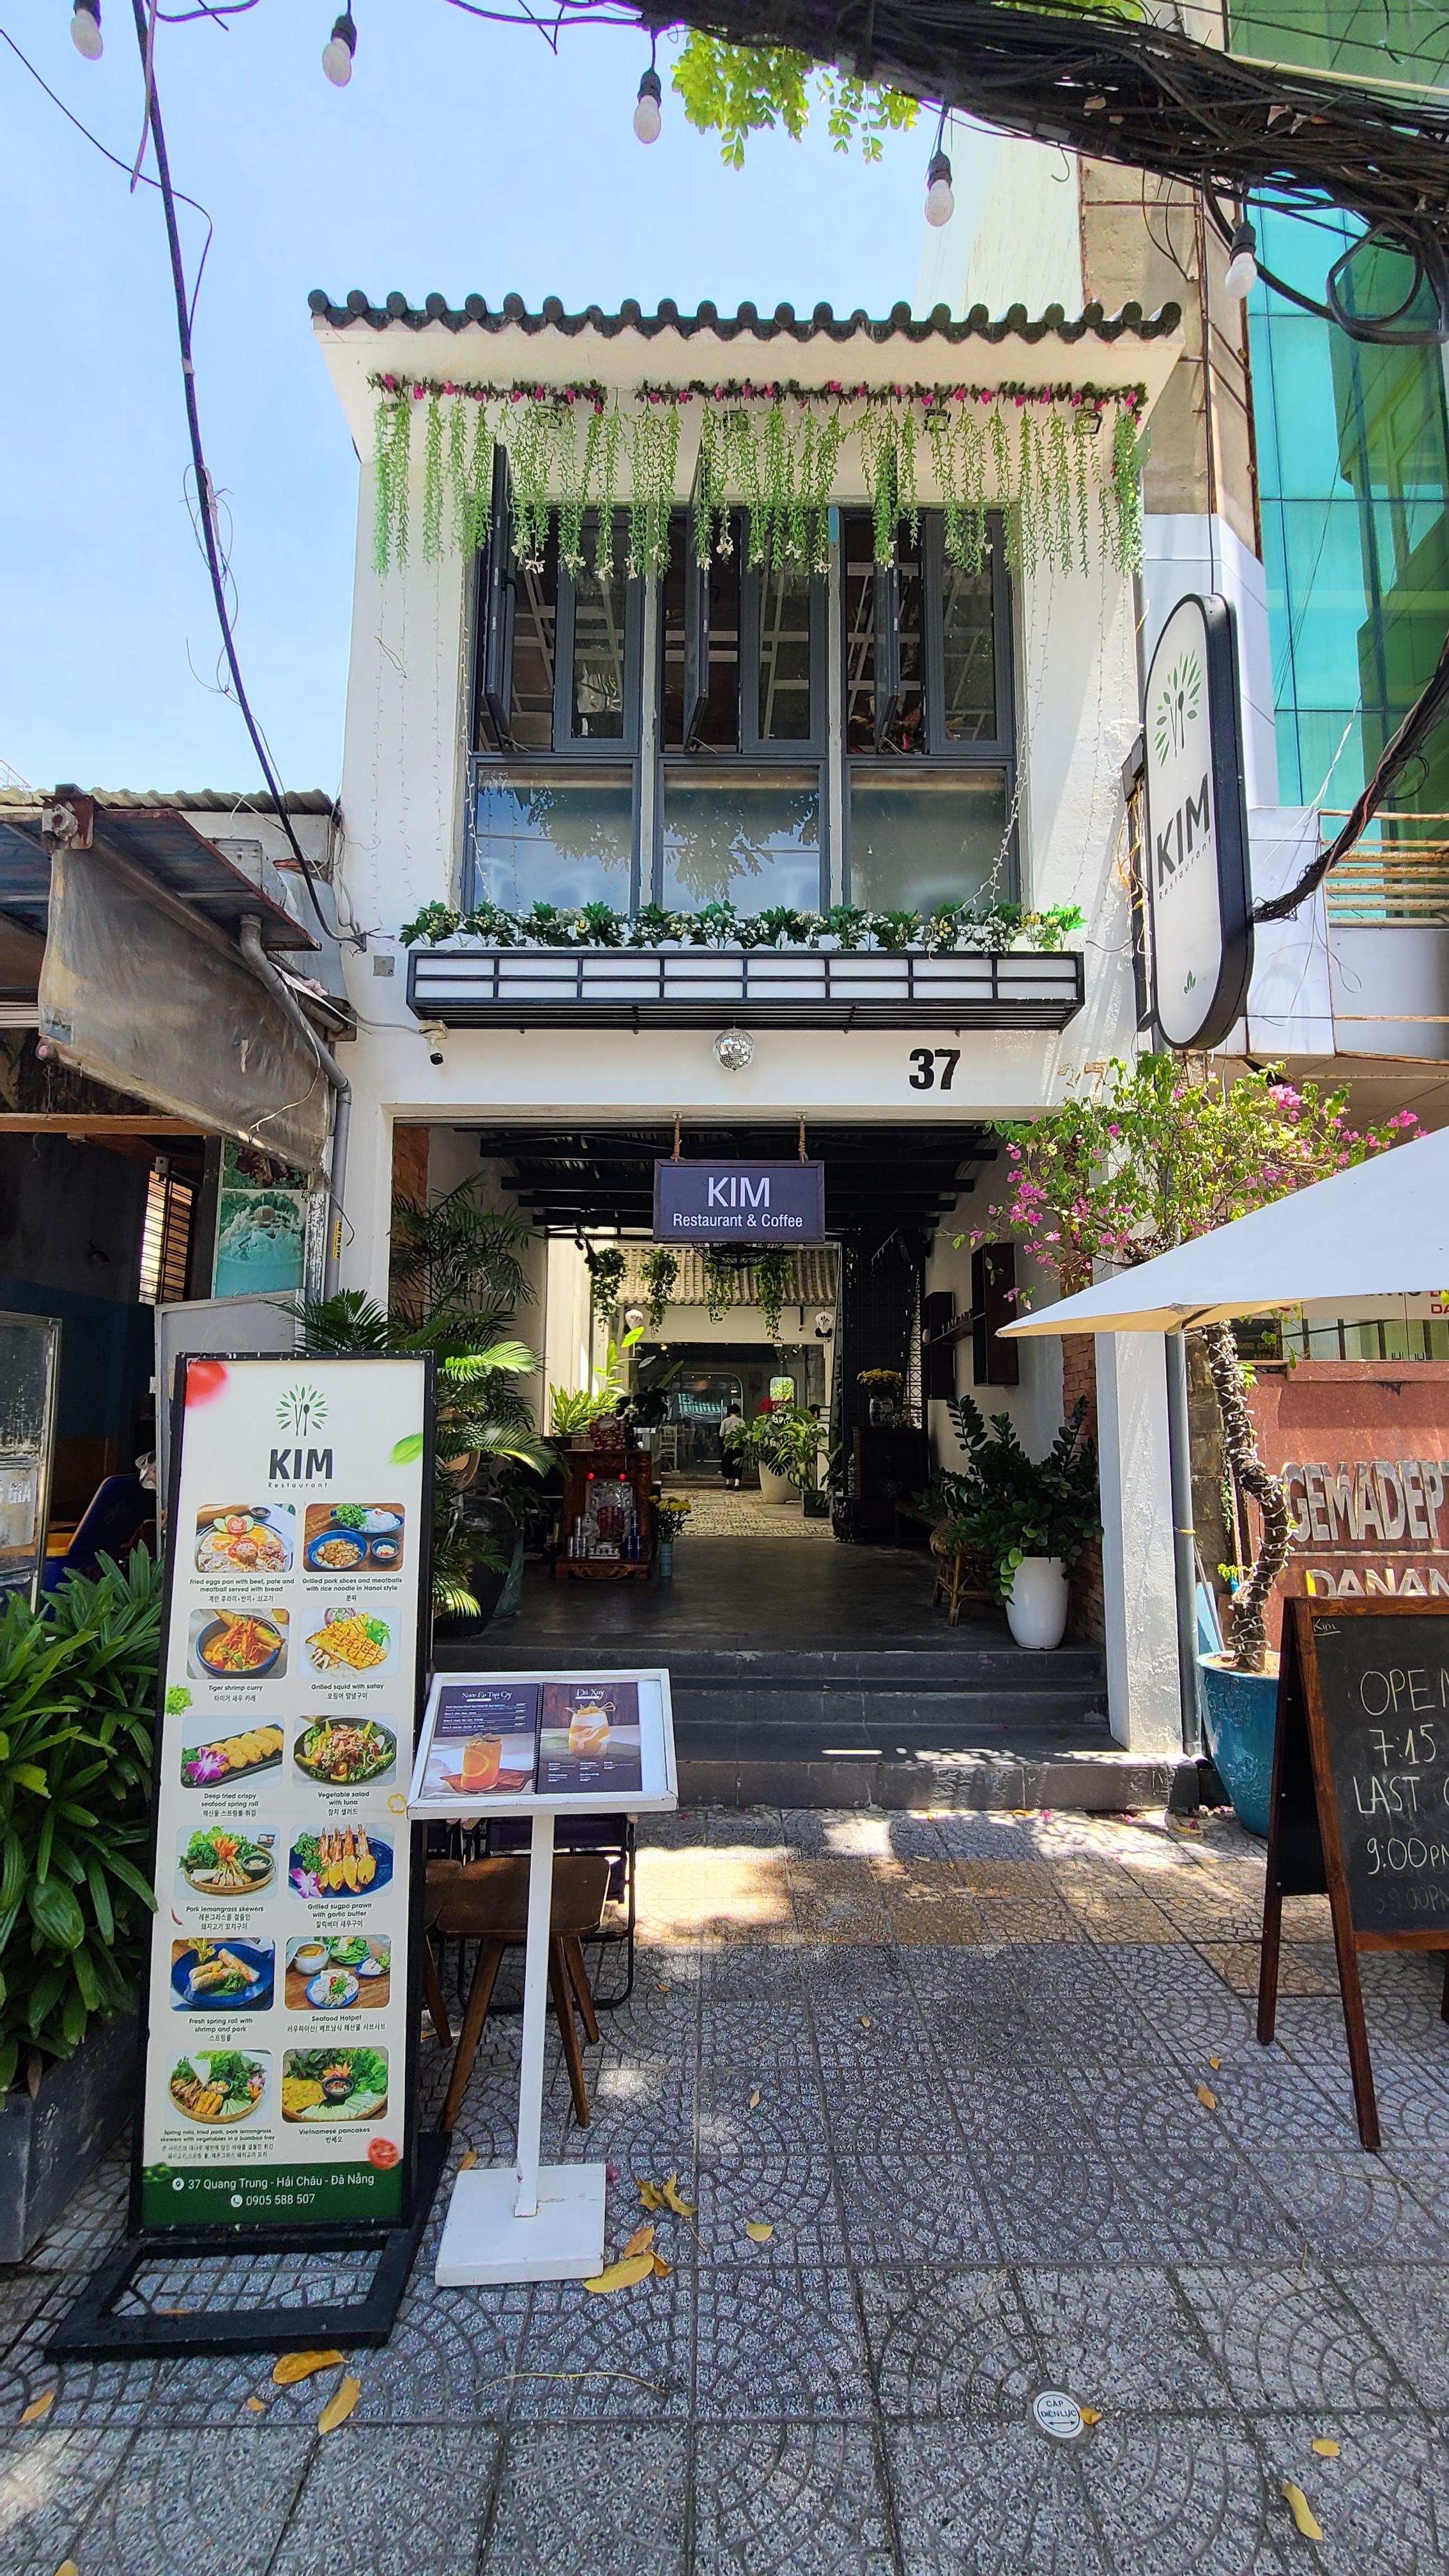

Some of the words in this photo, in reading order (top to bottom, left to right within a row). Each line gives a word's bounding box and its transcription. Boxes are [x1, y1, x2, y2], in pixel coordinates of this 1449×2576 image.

[1157, 772, 1210, 887] KIM
[1159, 835, 1211, 901] Restaurant
[909, 1048, 960, 1089] 37
[708, 1177, 770, 1207] KIM
[673, 1214, 742, 1227] Restaurant
[747, 1214, 756, 1227] &
[762, 1214, 803, 1227] Coffee
[269, 1449, 332, 1479] KIM
[1368, 1724, 1436, 1767] 7:15
[1353, 1775, 1420, 1814] LAST
[188, 2179, 201, 2189] 37
[204, 2179, 236, 2191] Quang
[238, 2178, 268, 2190] Trung
[296, 2175, 322, 2186] Châu
[331, 2174, 344, 2185] Đà
[246, 2195, 272, 2205] 0905
[275, 2194, 293, 2204] 588
[296, 2193, 316, 2204] 507
